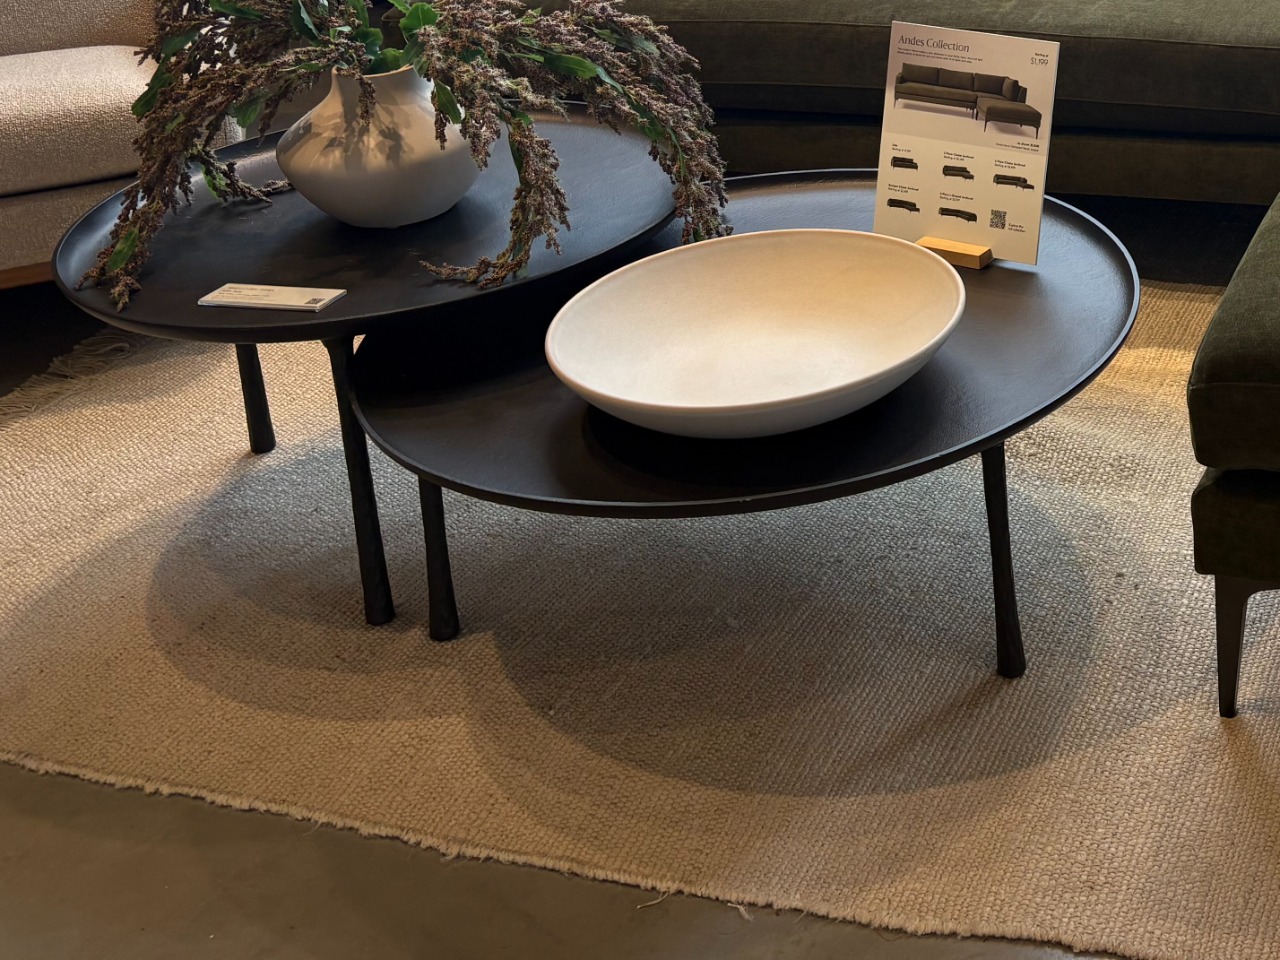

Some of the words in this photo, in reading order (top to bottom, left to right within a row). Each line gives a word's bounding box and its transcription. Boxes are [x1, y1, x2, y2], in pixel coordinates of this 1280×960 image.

[898, 35, 925, 47] Andes
[926, 38, 970, 53] Collection
[1030, 57, 1049, 66] $1,199
